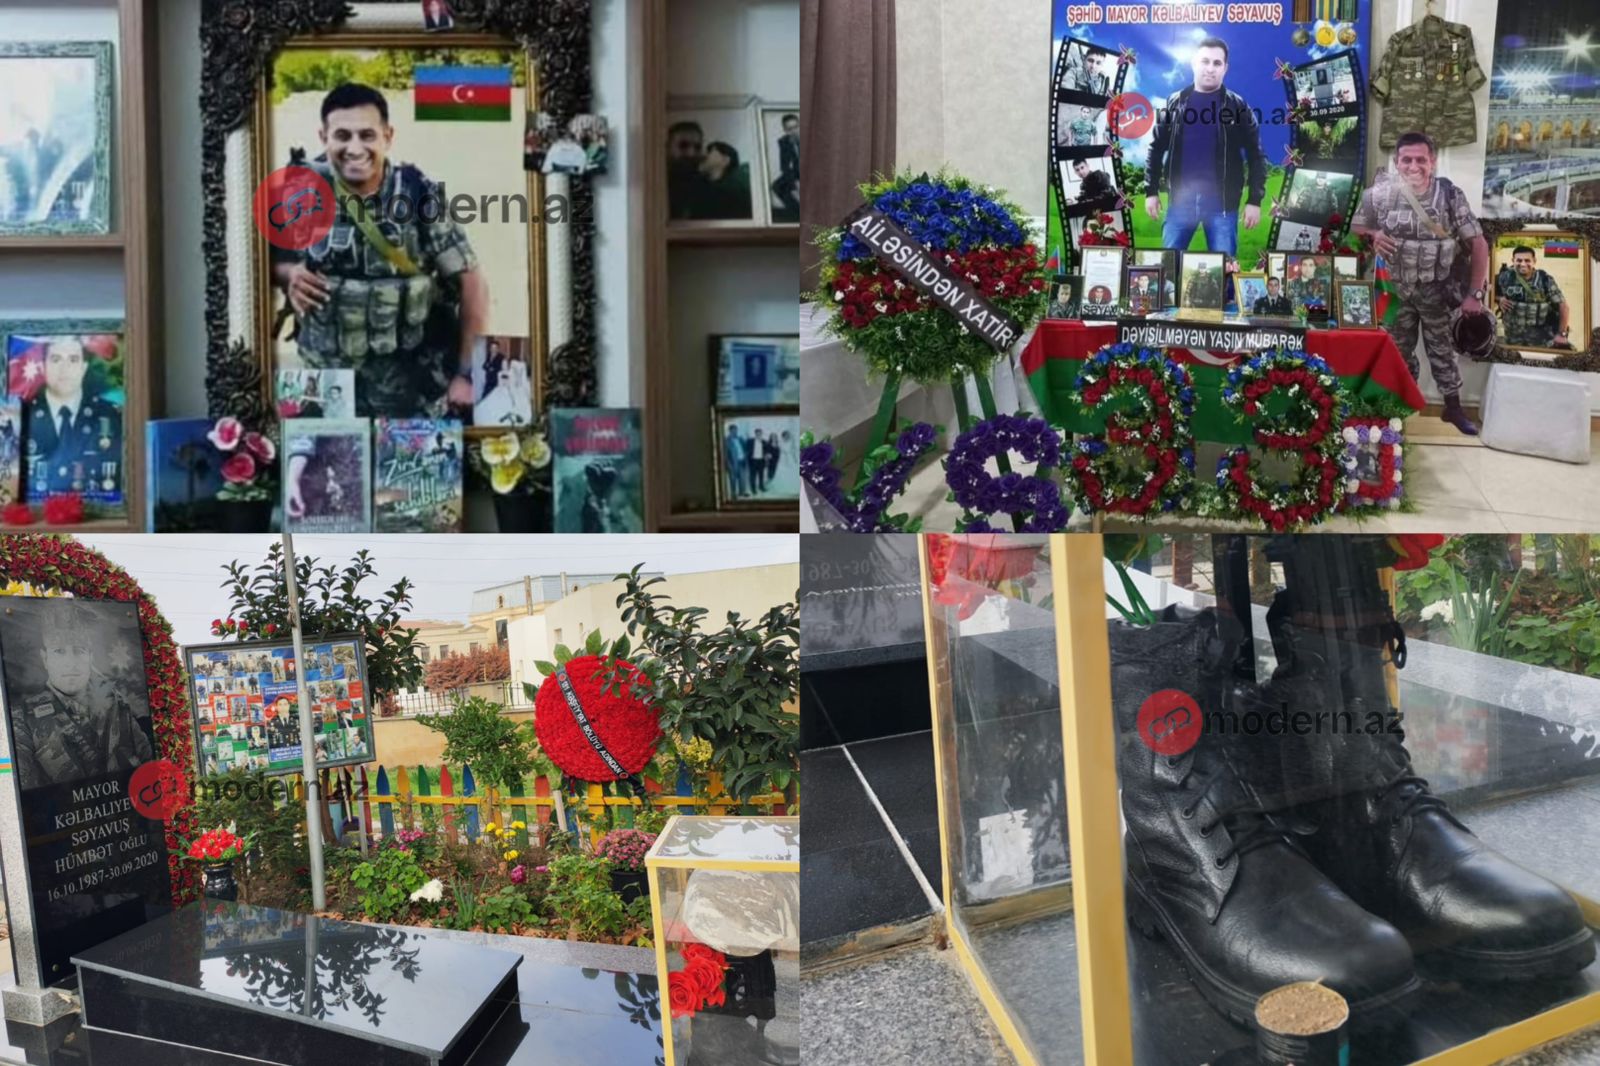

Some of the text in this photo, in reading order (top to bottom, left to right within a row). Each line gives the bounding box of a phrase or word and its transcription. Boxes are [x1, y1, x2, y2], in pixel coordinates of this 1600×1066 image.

[1067, 3, 1283, 27] ŞƏHİD MAYOR KƏLBALIYEV SƏYAVUŞ
[851, 215, 965, 306] AİLƏSİNDƏN
[1210, 330, 1243, 352] YAŞIN
[1245, 329, 1304, 351] MÜBARƏK
[72, 780, 120, 803] MAYOR
[71, 817, 131, 847] SƏYAVUŞ
[55, 833, 148, 874] HÜMBƏT OĞLU
[47, 850, 159, 902] 16.10.1987-30.09.2020
